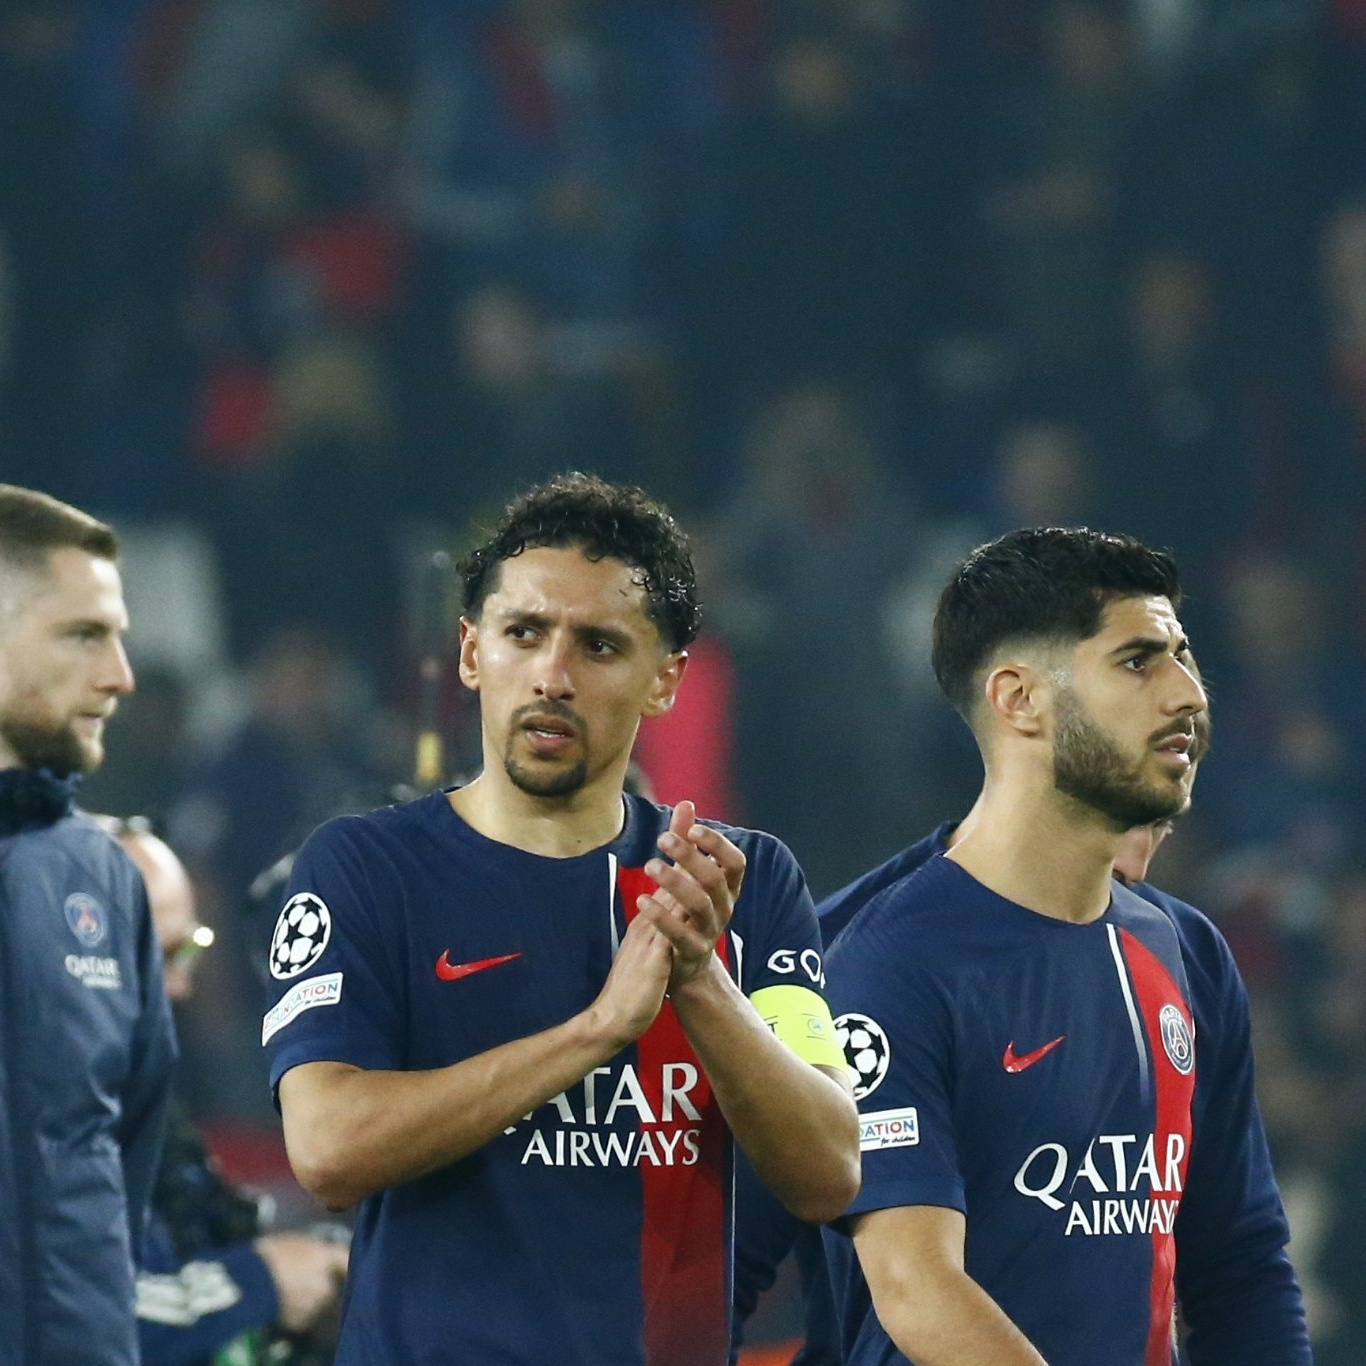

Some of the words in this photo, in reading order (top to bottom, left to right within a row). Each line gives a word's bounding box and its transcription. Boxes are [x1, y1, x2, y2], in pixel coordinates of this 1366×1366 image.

[520, 1129, 701, 1167] AIRWAYS
[1013, 1132, 1185, 1211] QATAR
[1064, 1198, 1180, 1236] AIRWAY
